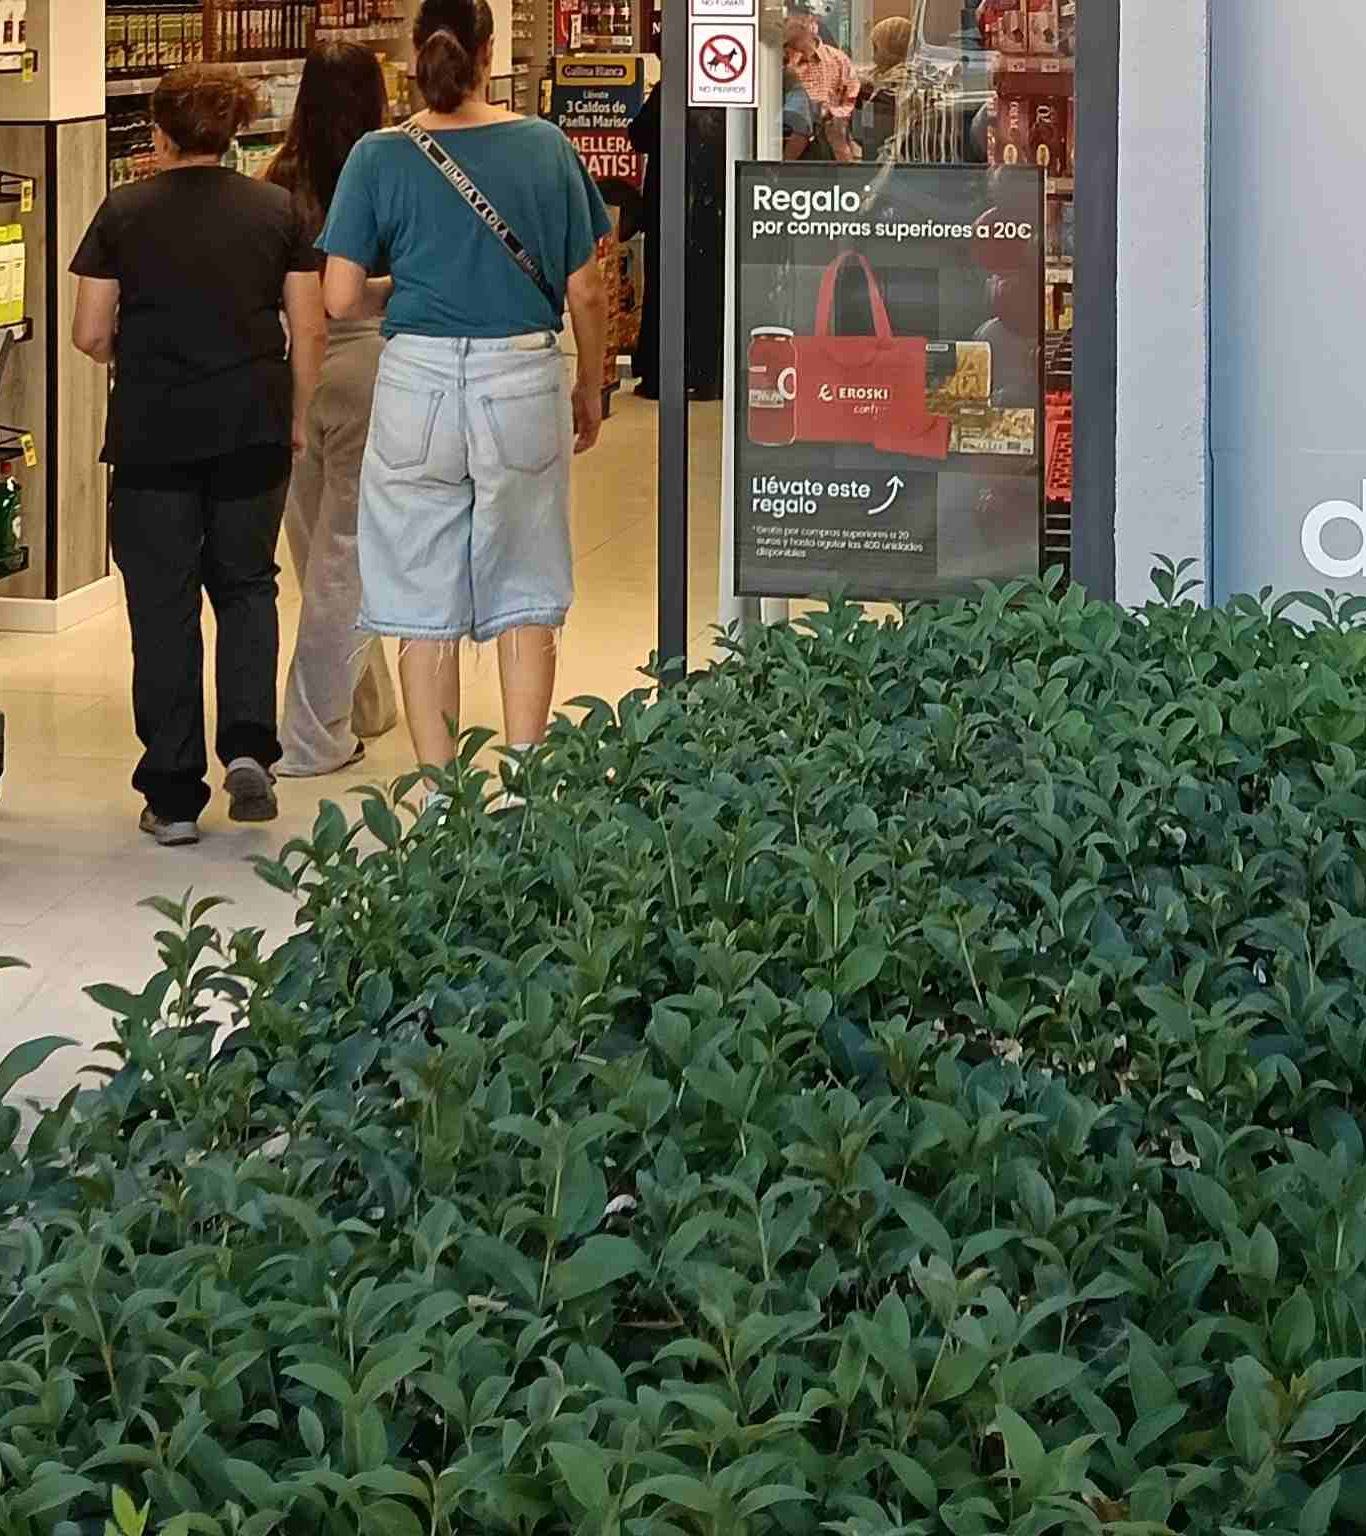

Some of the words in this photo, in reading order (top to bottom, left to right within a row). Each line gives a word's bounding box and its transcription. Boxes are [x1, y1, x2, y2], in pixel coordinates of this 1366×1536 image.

[701, 0, 714, 7] NO
[699, 86, 711, 94] NO
[566, 100, 573, 113] 3
[575, 100, 611, 113] Caldos
[612, 100, 627, 114] de
[558, 114, 591, 127] Paella
[580, 154, 637, 177] ATIS!
[752, 220, 784, 239] por
[787, 221, 871, 241] compras
[875, 219, 973, 242] superiores
[976, 224, 989, 239] a
[993, 222, 1033, 240] 20€
[838, 387, 889, 401] EROSKI
[751, 475, 824, 495] Llévate
[827, 481, 871, 499] este
[752, 497, 818, 519] regalo
